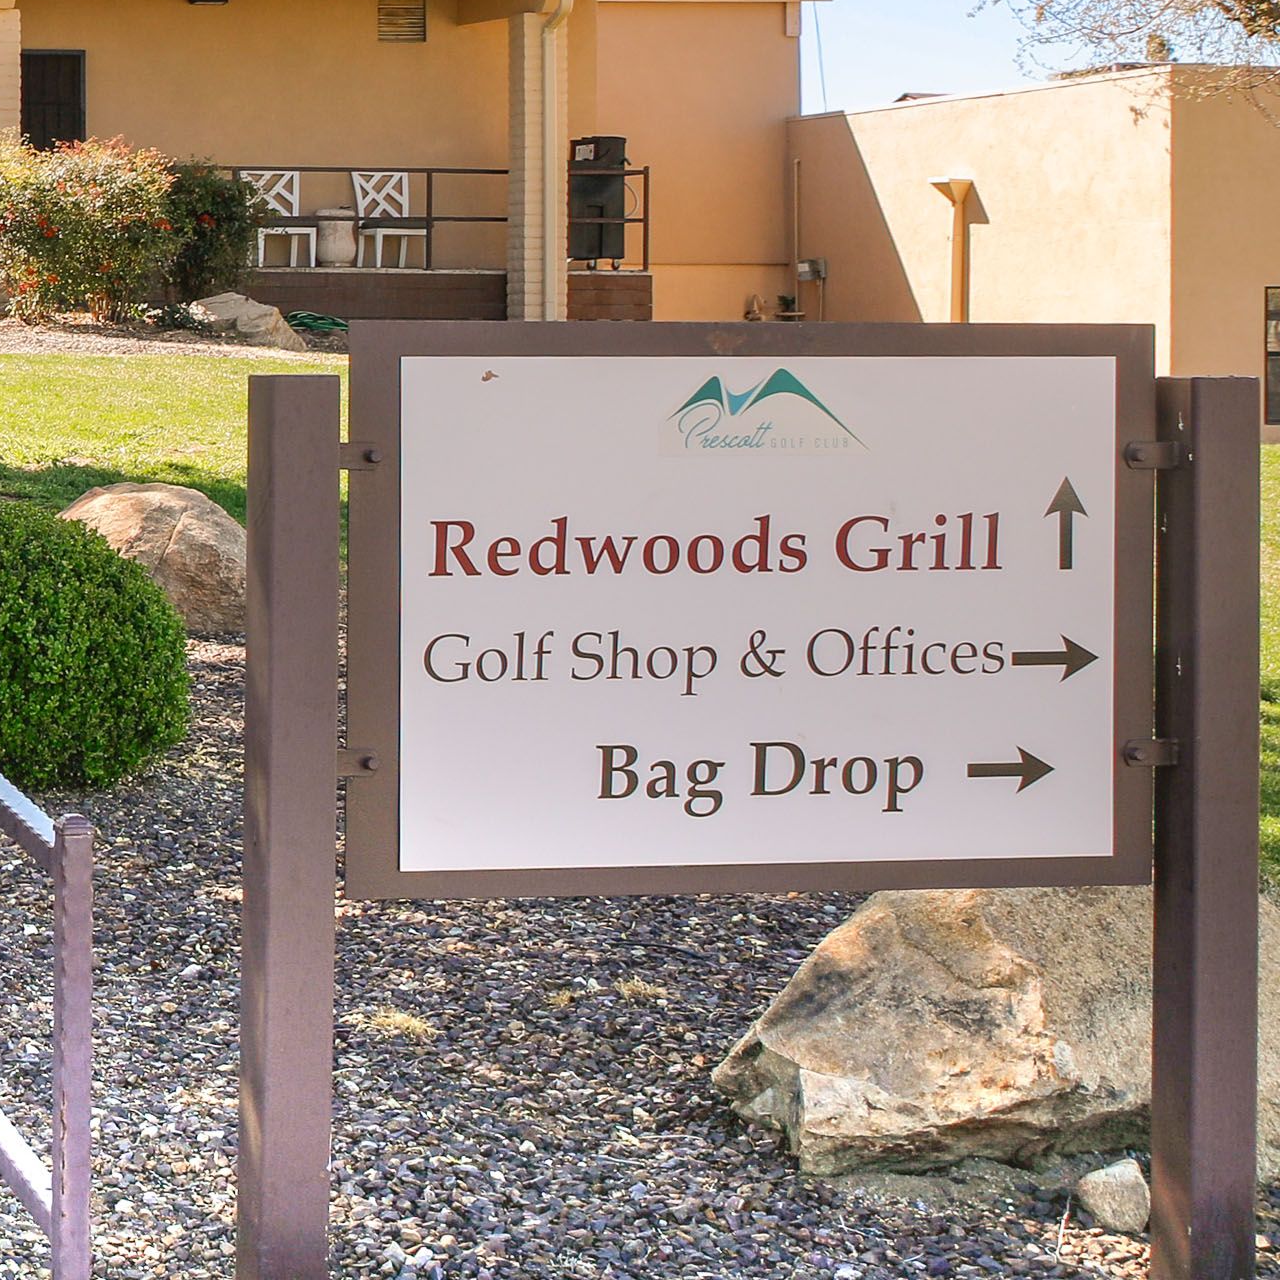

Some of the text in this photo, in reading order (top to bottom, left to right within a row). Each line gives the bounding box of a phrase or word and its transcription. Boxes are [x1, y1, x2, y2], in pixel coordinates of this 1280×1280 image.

[677, 402, 850, 449] Prescott GOLF CLUB
[428, 512, 1002, 577] Redwoods Grill
[423, 625, 1005, 696] Golf Shop & Offices
[596, 741, 924, 817] Bag Drop
